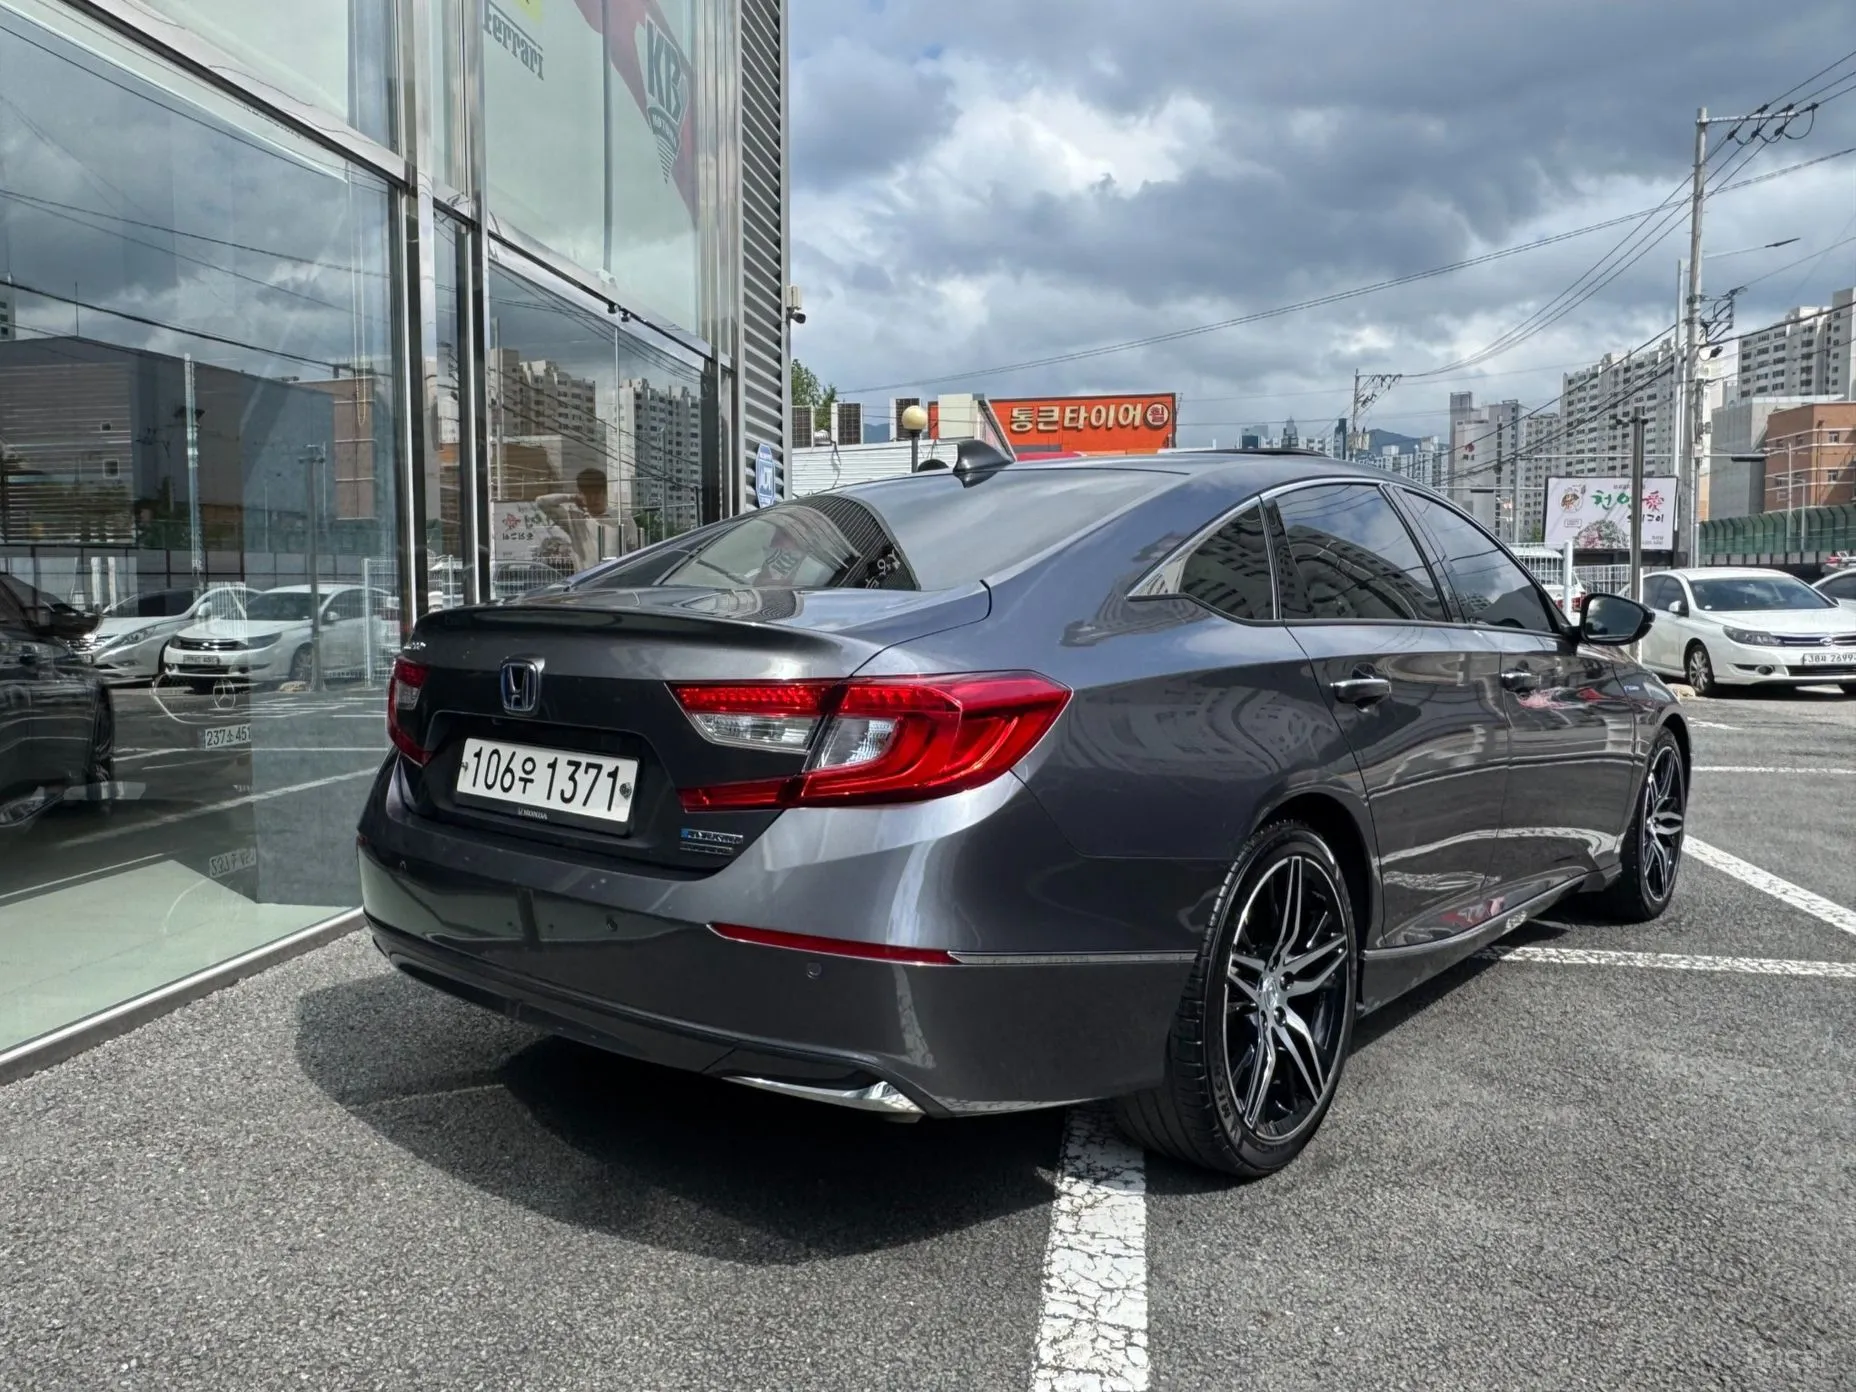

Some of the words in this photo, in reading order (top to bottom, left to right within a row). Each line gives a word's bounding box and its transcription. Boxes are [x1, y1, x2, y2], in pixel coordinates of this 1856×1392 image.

[483, 0, 545, 81] Ferrari
[646, 19, 682, 124] KB
[1011, 404, 1142, 431] 통큰타이어
[207, 729, 234, 746] 237소
[473, 746, 536, 794] 106우
[547, 757, 619, 812] 1371
